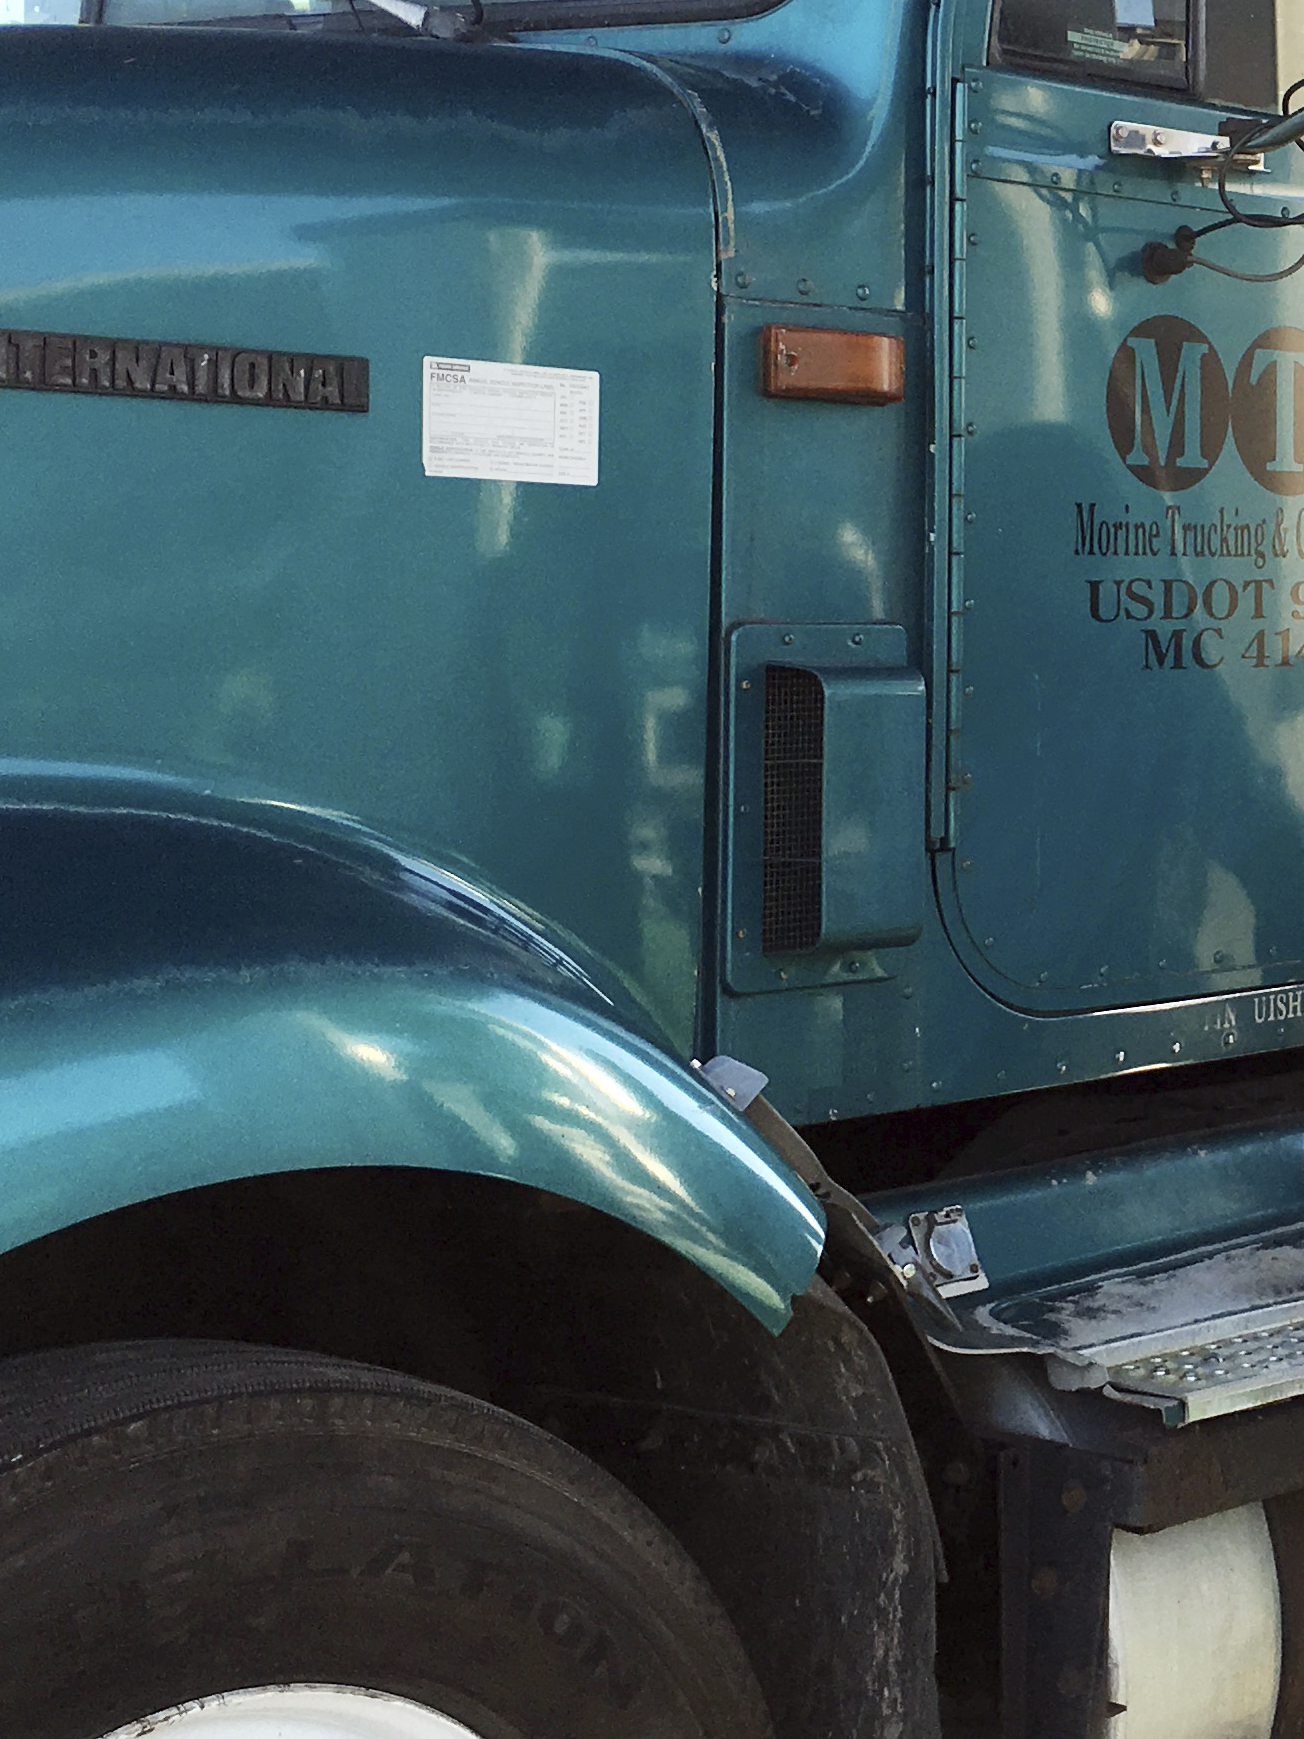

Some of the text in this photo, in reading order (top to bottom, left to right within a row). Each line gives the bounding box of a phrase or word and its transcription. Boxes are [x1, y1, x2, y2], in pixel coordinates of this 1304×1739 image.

[0, 330, 367, 405] TERNATIONAL
[430, 372, 467, 385] FMCSA
[1074, 502, 1161, 557] Morine
[1165, 504, 1266, 569] Trucking
[1272, 506, 1289, 558] &
[1086, 578, 1275, 623] USDOT
[1141, 627, 1224, 670] MC
